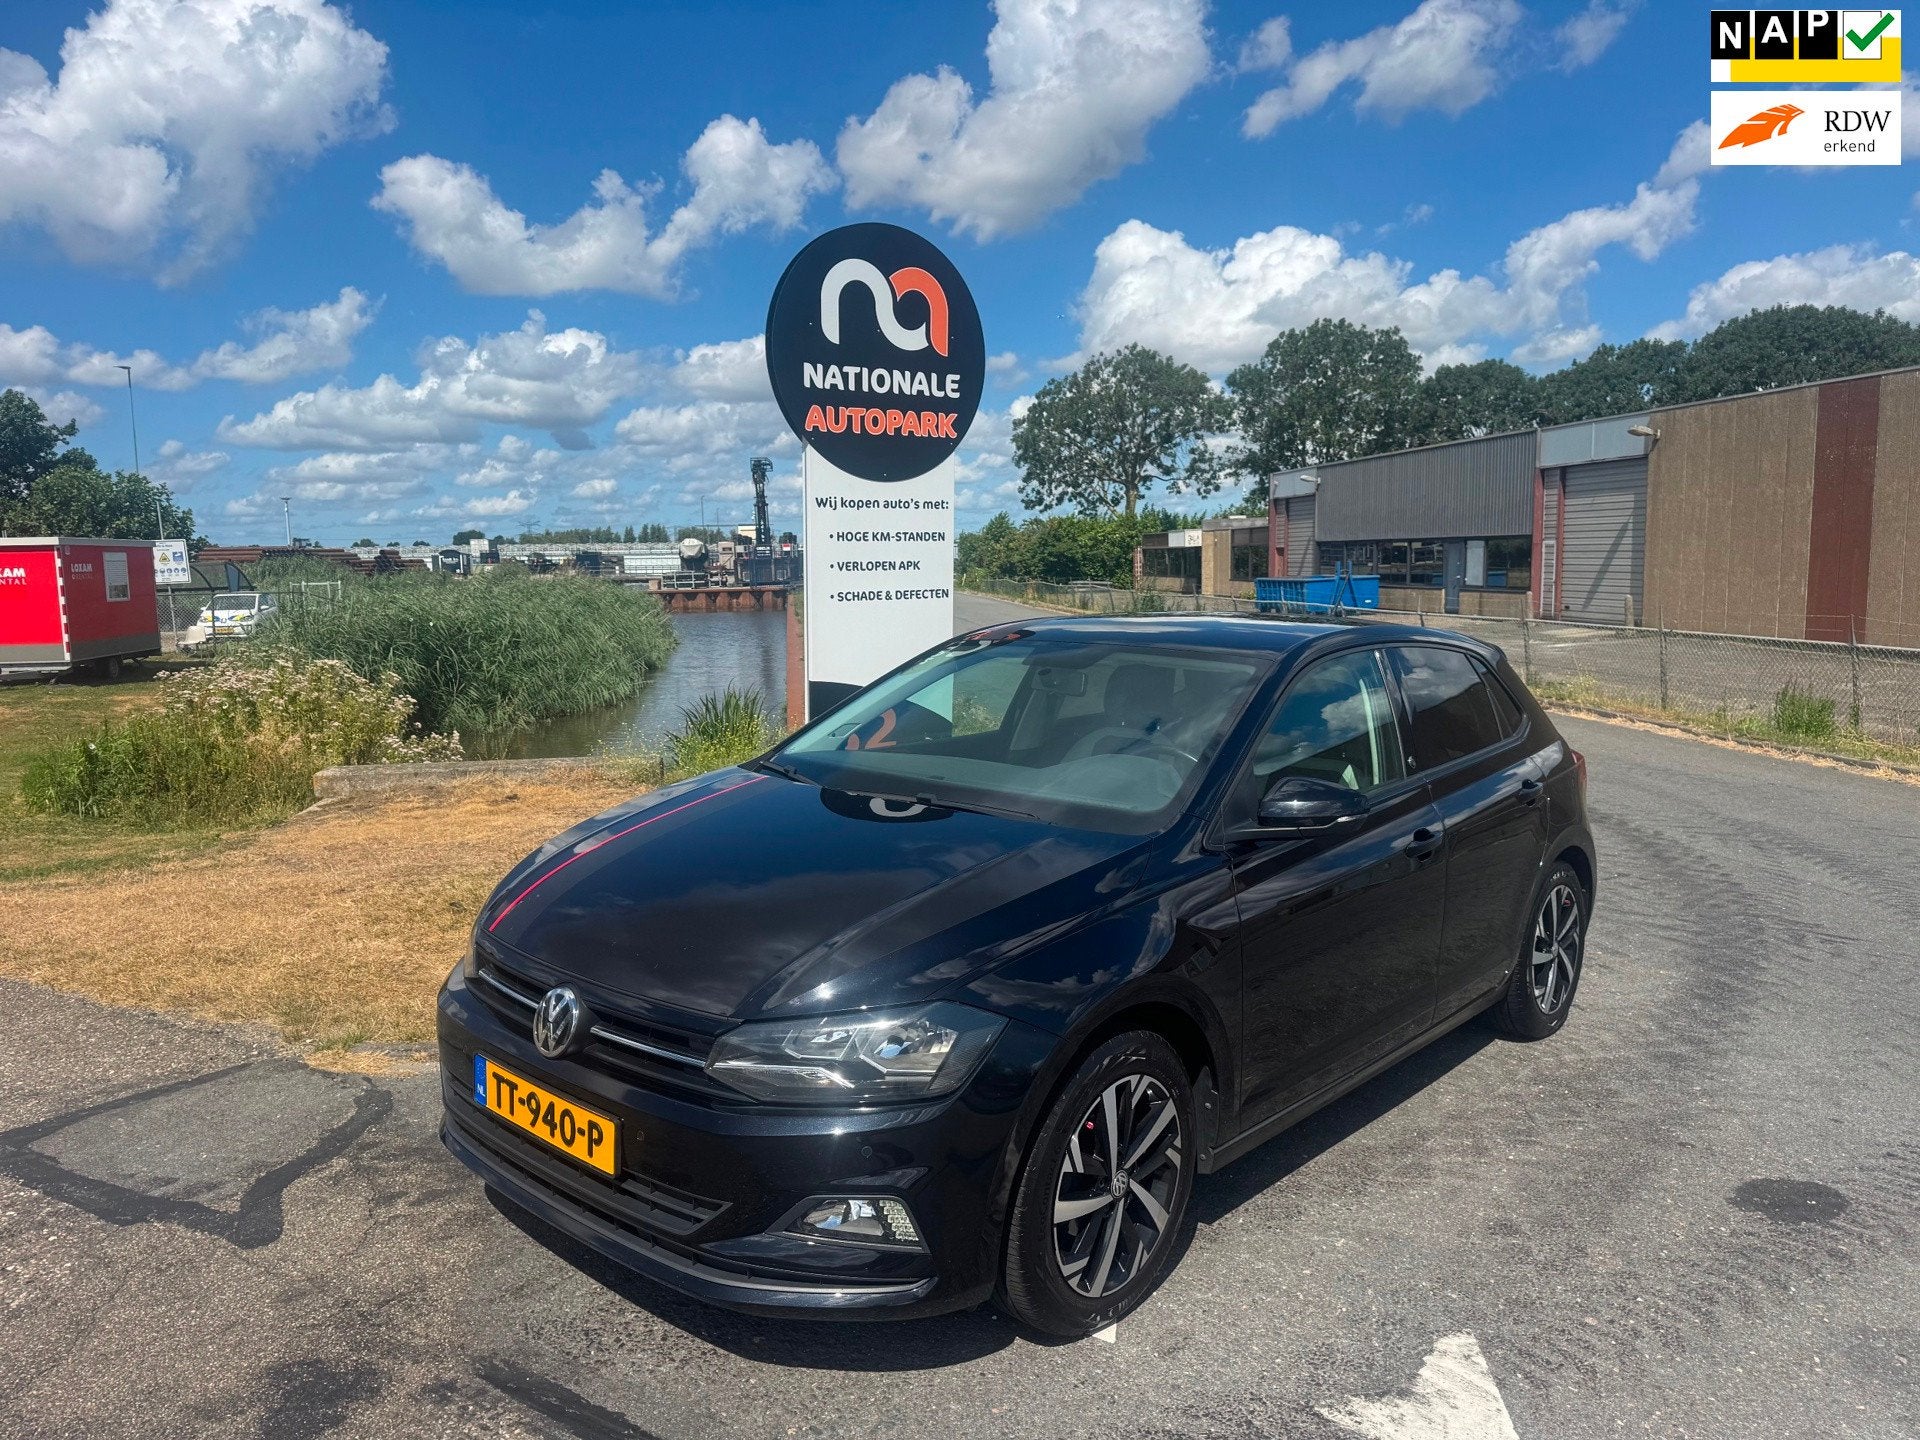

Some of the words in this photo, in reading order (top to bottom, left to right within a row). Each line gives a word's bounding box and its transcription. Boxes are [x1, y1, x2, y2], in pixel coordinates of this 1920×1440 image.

[803, 362, 961, 399] NATIONALE
[805, 404, 958, 438] AUTOPARK
[815, 496, 838, 511] Wij
[840, 497, 880, 511] kopen
[883, 498, 920, 509] auto's
[922, 499, 949, 509] met:
[836, 531, 869, 542] HOGE
[872, 531, 946, 542] KM-STANDEN
[837, 561, 896, 572] VERLOPEN
[898, 560, 921, 571] APK
[837, 591, 883, 602] SCHADE
[884, 590, 893, 600] &
[895, 588, 950, 600] DEFECTEN
[491, 1071, 604, 1158] TT-940-P
